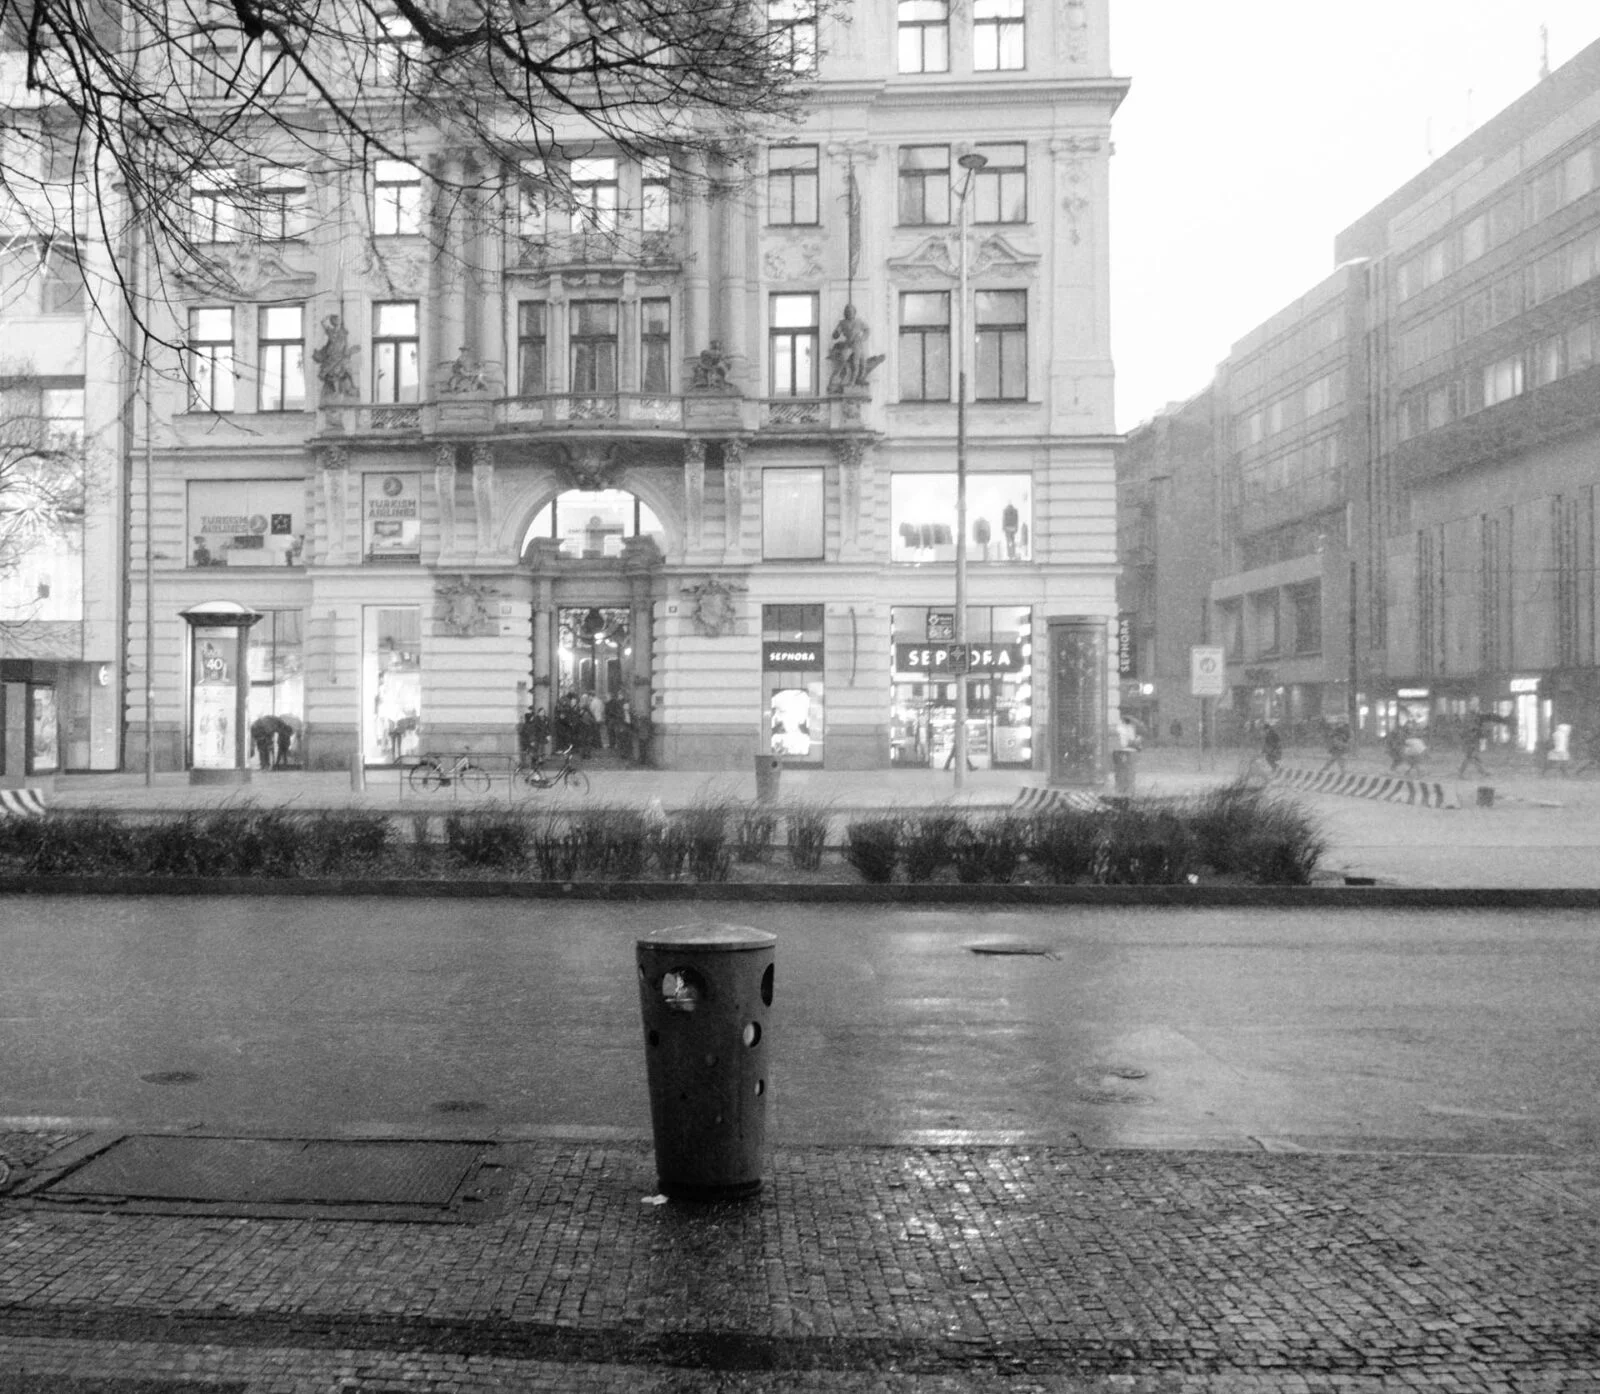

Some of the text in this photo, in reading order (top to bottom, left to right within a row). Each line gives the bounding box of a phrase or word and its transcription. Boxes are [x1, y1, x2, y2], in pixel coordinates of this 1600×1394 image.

[369, 499, 416, 508] TURKISH
[200, 516, 248, 525] TURKISH
[1120, 619, 1130, 673] SEPHORA
[769, 651, 816, 661] SEPHORA
[908, 649, 1011, 666] SEPORA
[206, 658, 223, 670] 40
